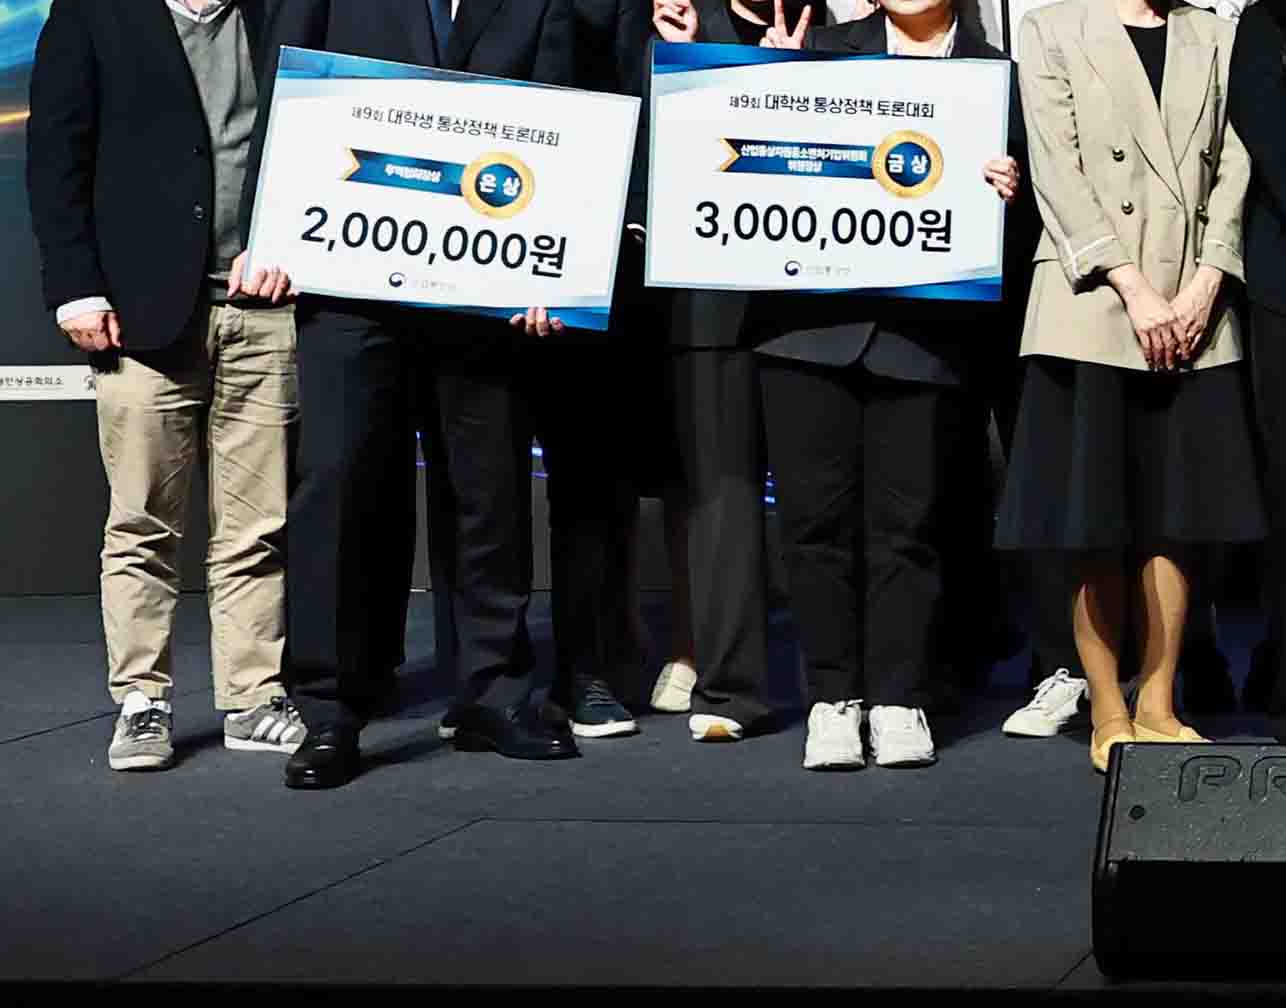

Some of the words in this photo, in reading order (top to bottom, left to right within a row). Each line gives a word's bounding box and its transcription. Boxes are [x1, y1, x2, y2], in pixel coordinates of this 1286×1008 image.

[351, 106, 384, 123] 제9회
[388, 108, 434, 130] 대학생
[437, 115, 498, 139] 통상정책
[501, 125, 560, 147] 토론대회
[729, 95, 761, 110] 제9회
[765, 94, 810, 113] 대학생
[814, 97, 873, 116] 통상정책
[876, 101, 934, 119] 토론대회
[301, 206, 568, 279] 2,000,000원
[695, 201, 953, 253] 3,000,000원
